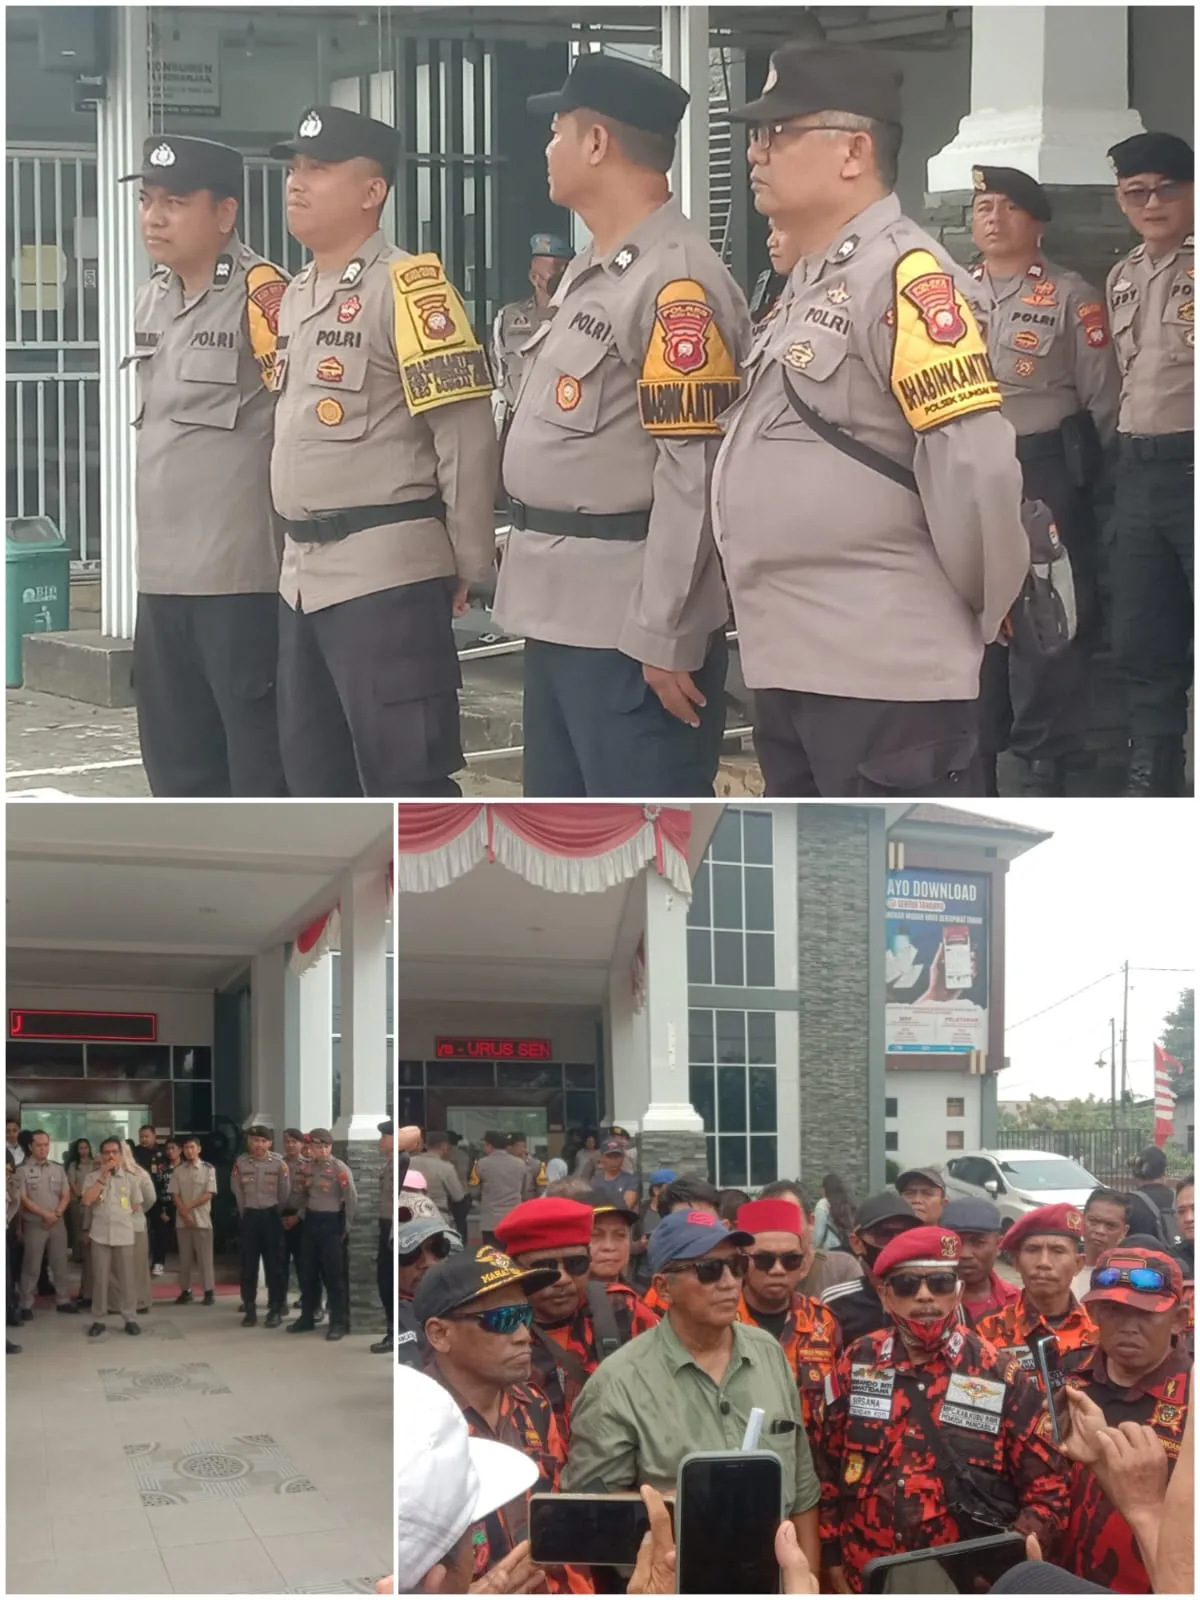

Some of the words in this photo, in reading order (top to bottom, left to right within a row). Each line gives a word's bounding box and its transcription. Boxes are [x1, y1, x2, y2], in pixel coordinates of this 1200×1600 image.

[567, 311, 612, 344] POLRI
[804, 307, 851, 336] POLRI
[1011, 311, 1056, 327] POLRI
[190, 330, 234, 348] POLRI
[316, 330, 362, 348] POLRI
[925, 396, 958, 416] POLSEK
[887, 879, 909, 897] AYO
[913, 880, 976, 901] DOWNLOAD
[467, 1041, 514, 1056] URUS
